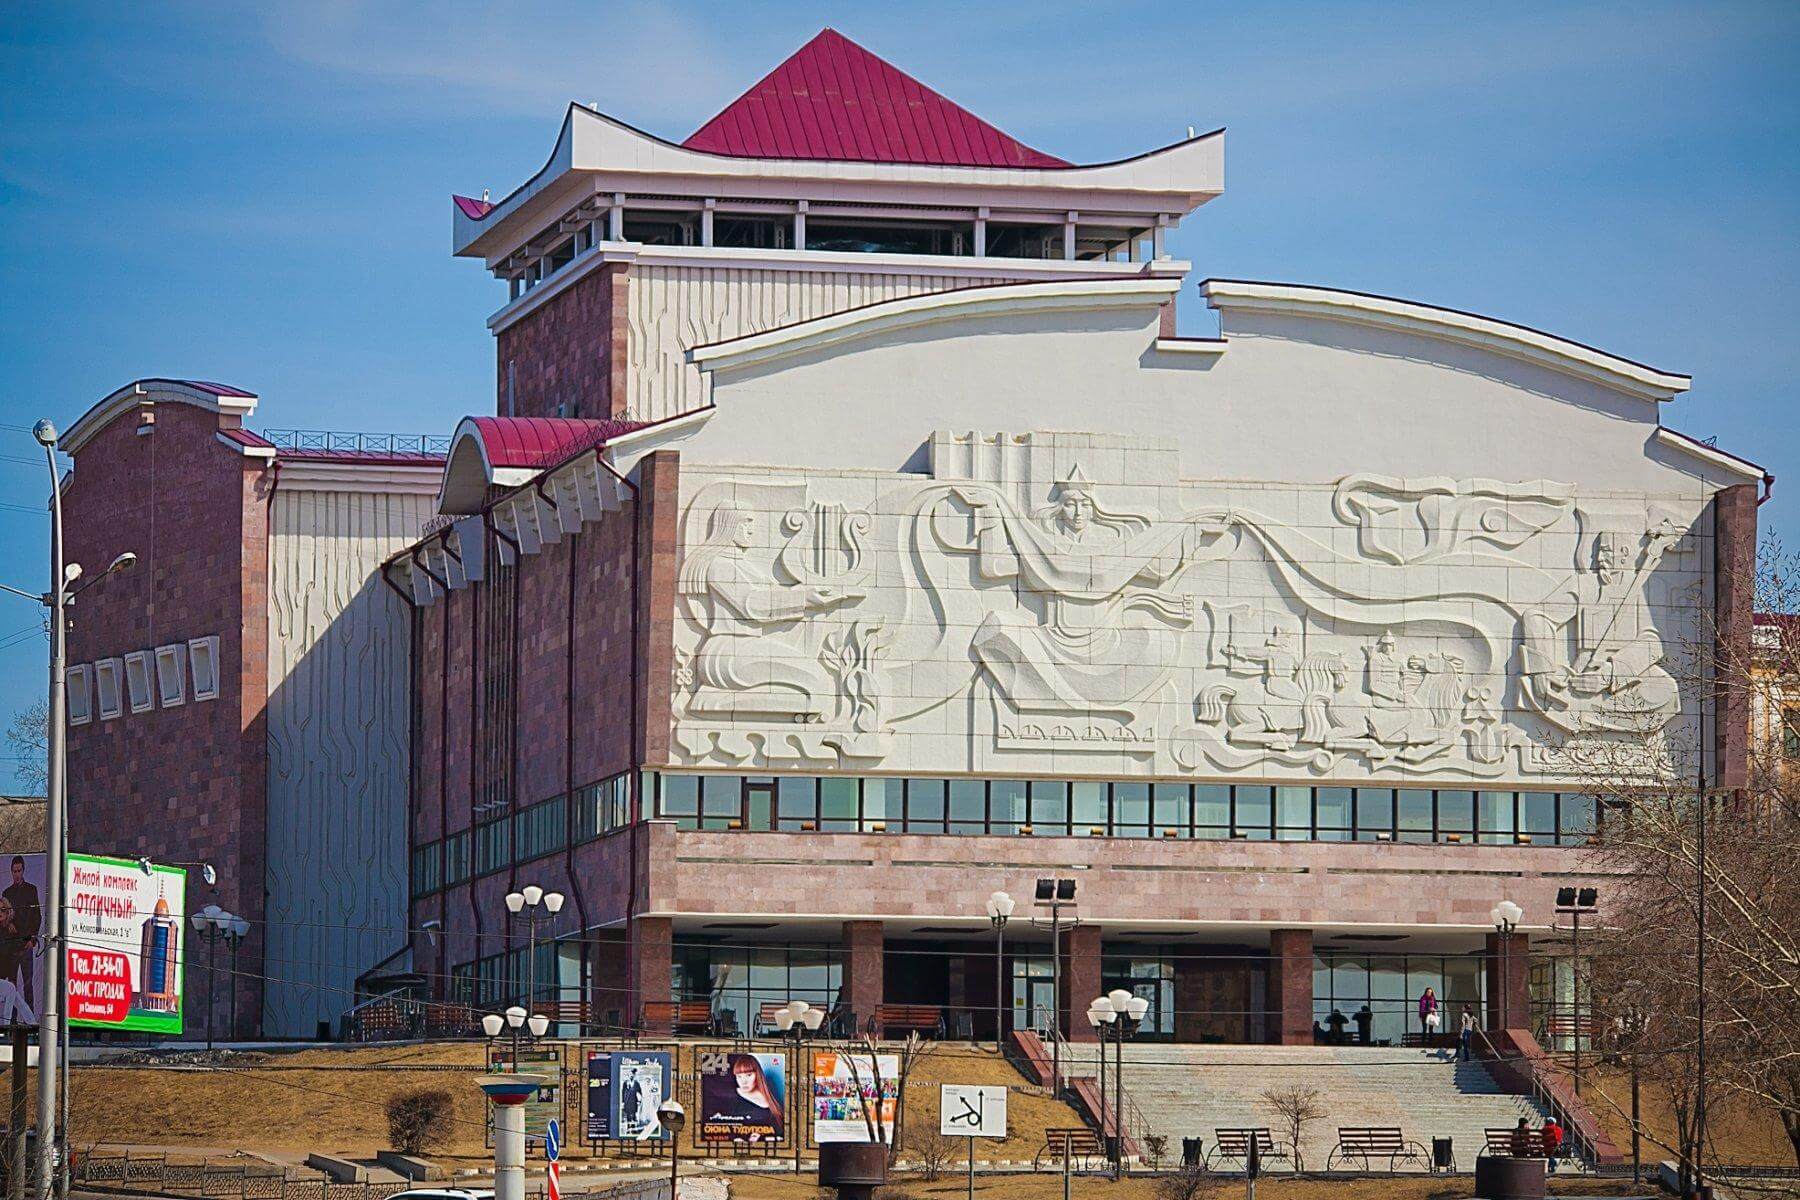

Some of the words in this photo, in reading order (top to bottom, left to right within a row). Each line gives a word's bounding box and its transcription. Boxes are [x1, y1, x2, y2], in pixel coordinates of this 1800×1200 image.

[73, 867, 100, 887] Жилой
[103, 875, 138, 891] комплекс
[71, 953, 90, 975] Тел.
[68, 978, 93, 998] ОФИС
[93, 981, 126, 1000] ПРОДАЖ
[702, 1053, 730, 1072] 24
[704, 1125, 731, 1134] ОЮНА
[732, 1125, 776, 1135] ТУДУПОВА
